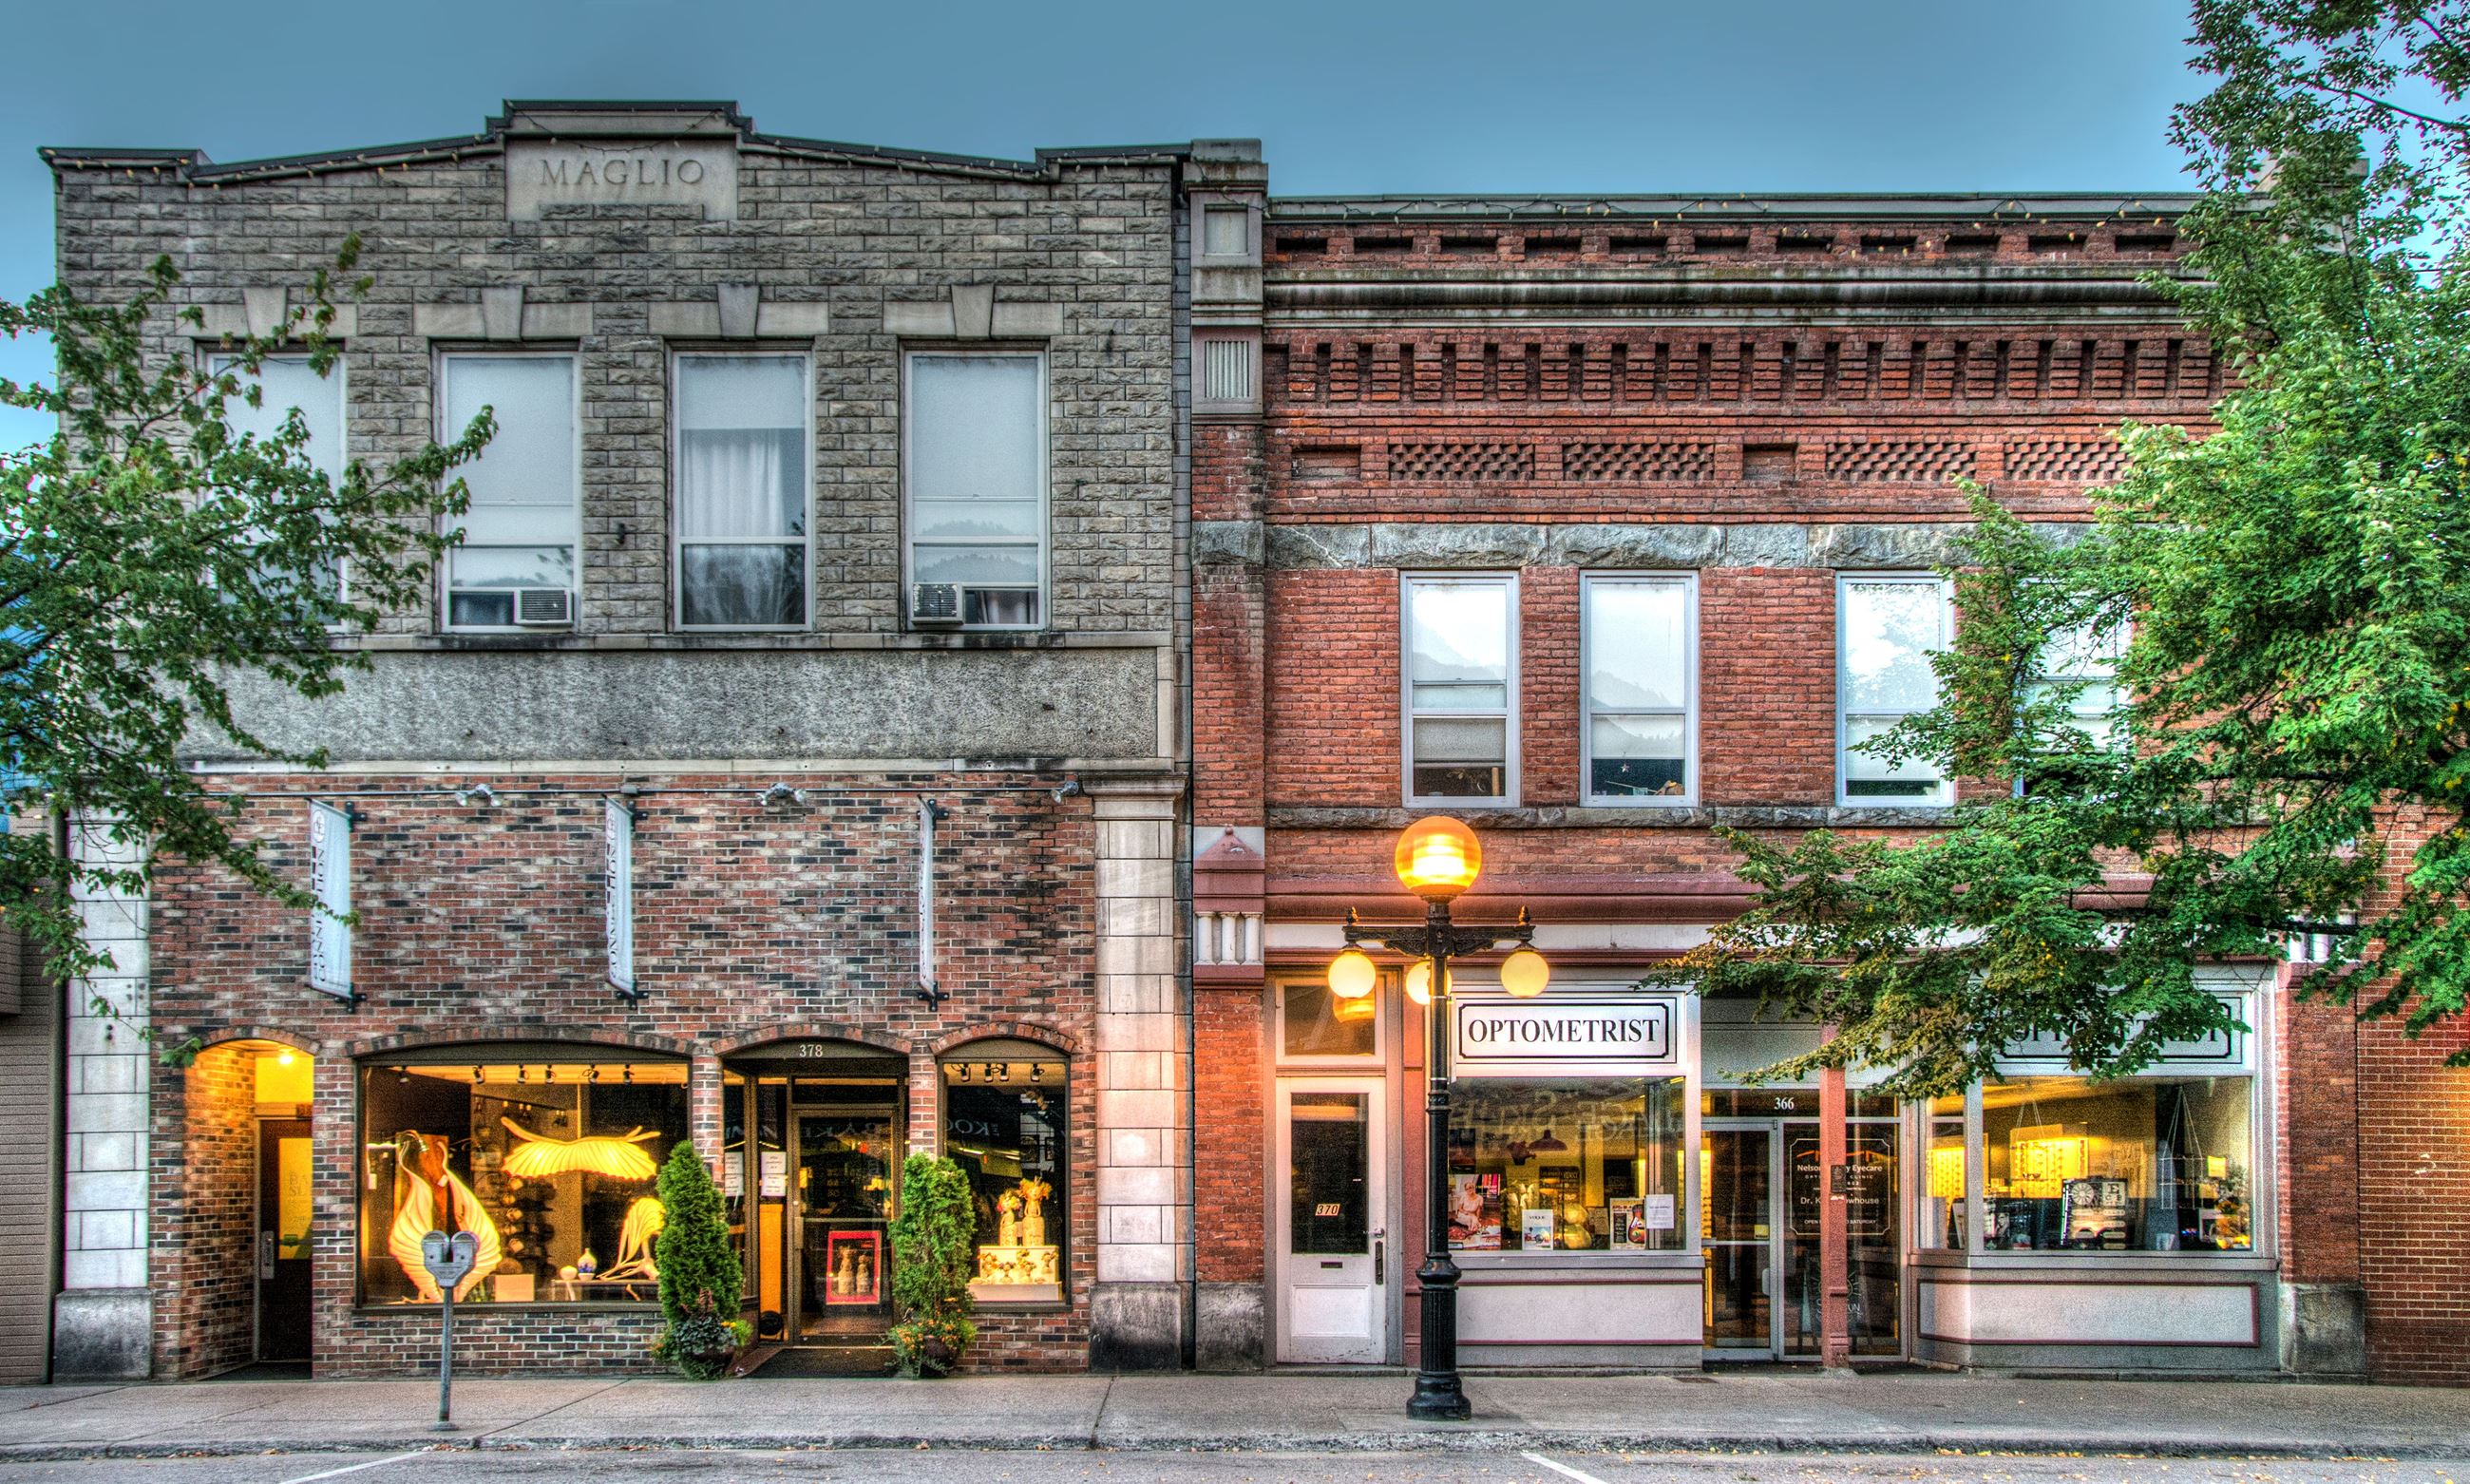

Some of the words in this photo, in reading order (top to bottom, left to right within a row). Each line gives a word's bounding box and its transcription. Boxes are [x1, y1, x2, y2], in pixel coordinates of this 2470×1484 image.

[540, 158, 705, 186] MAGLIO
[1468, 1018, 1661, 1043] OPTOMETRIST
[799, 1044, 824, 1057] 378
[1774, 1096, 1795, 1111] 366
[1852, 1165, 1883, 1173] Eyecare
[1317, 1205, 1339, 1215] 370
